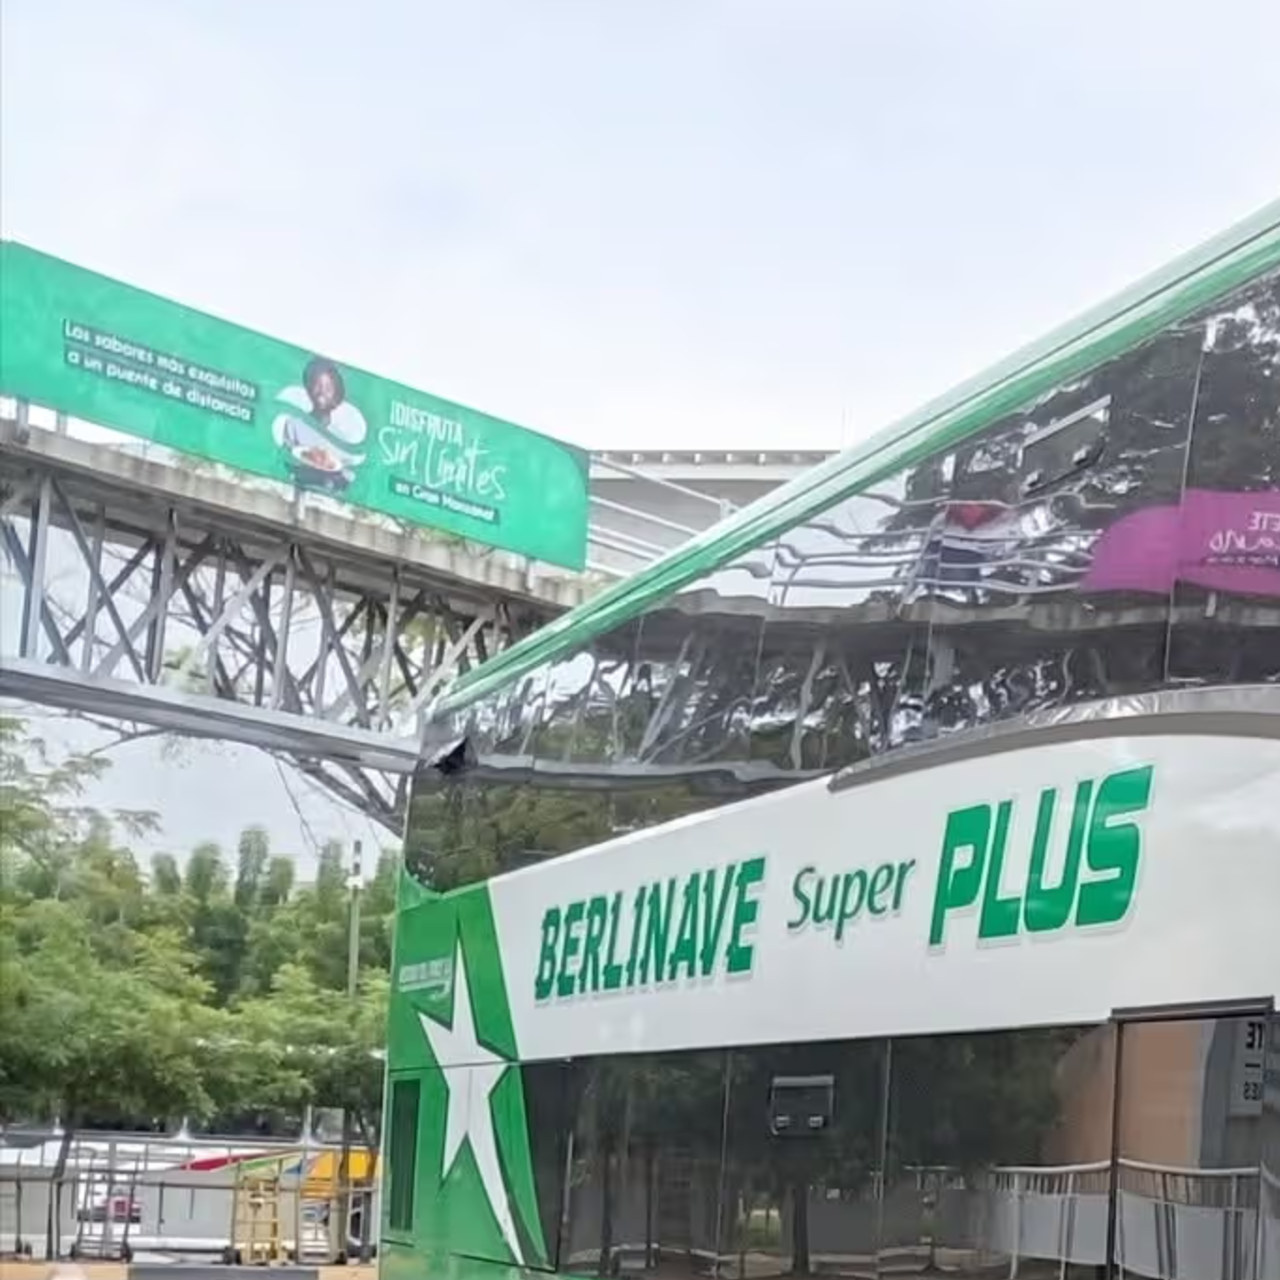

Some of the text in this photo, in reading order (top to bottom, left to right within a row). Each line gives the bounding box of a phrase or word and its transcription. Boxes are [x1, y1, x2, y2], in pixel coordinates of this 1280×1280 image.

[106, 363, 159, 391] puente
[162, 379, 183, 398] de
[186, 387, 252, 422] distancia
[534, 764, 1155, 1002] BERLINAVE Super PLUS
